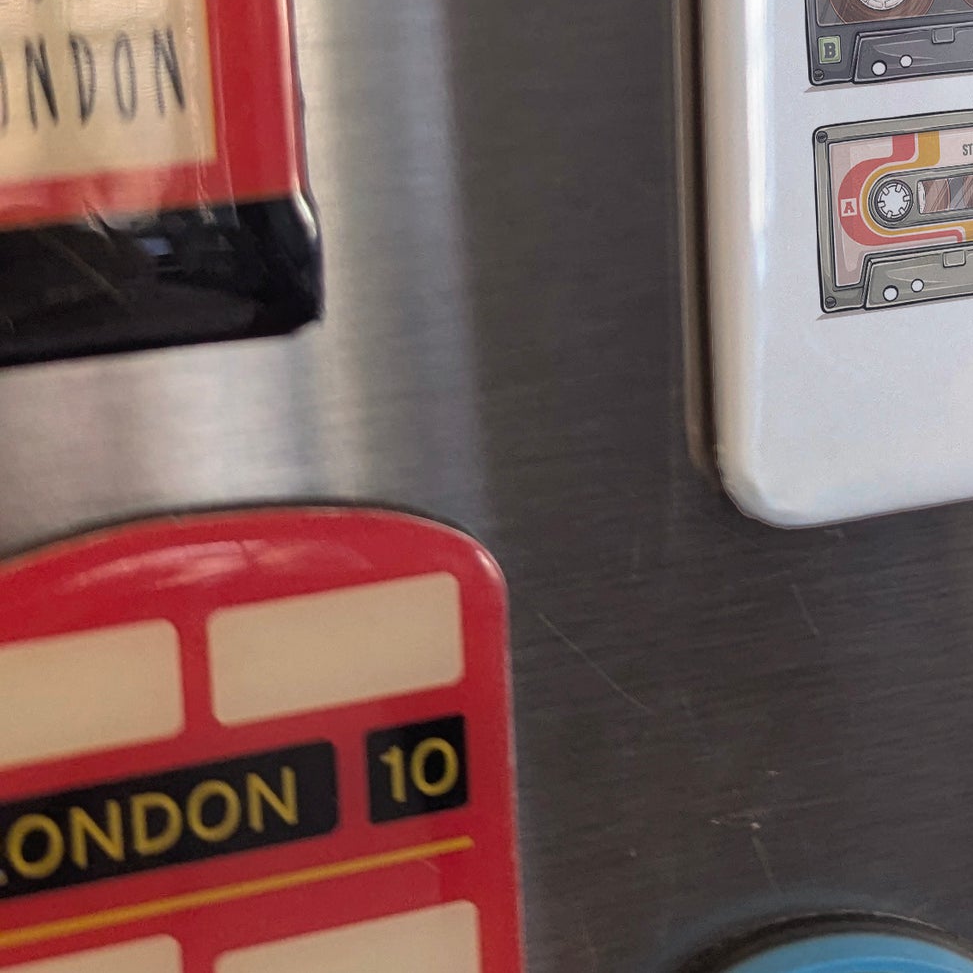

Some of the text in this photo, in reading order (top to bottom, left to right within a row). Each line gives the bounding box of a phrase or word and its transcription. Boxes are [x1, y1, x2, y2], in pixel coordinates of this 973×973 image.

[823, 42, 837, 59] B
[0, 27, 186, 131] NDON
[843, 200, 855, 215] A
[381, 737, 459, 803] 10
